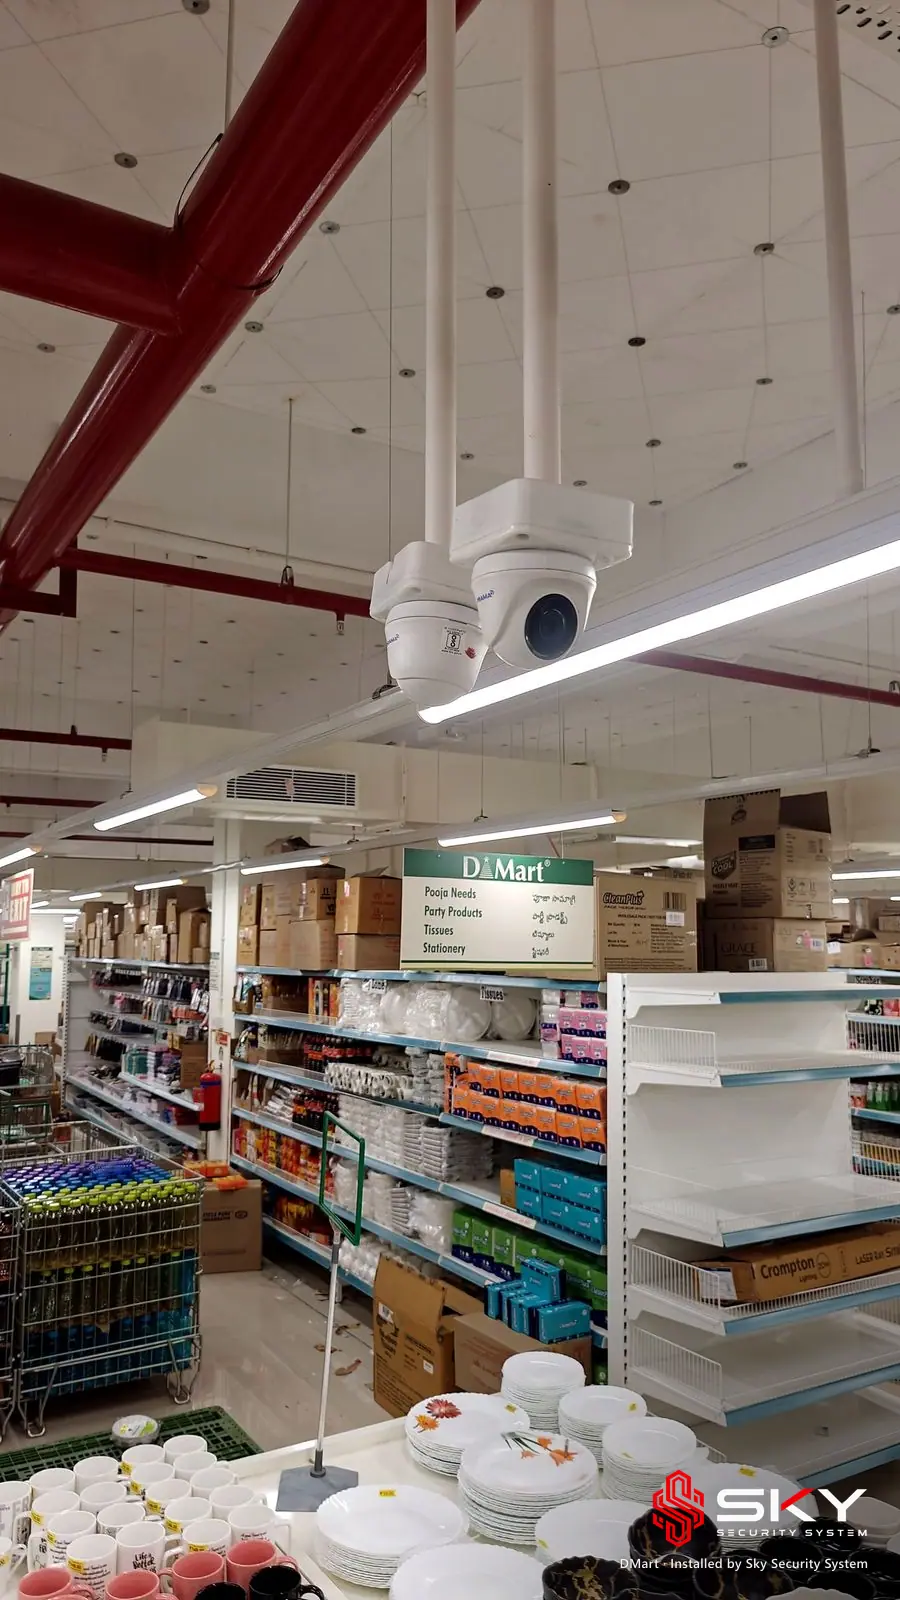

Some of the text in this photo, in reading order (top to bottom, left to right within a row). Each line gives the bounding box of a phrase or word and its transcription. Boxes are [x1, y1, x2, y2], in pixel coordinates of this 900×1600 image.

[424, 886, 477, 900] Pooja Needs
[602, 890, 645, 905] CleanPlus
[424, 905, 483, 919] Party Products
[423, 924, 454, 936] Tissues
[423, 942, 466, 956] Stationery
[481, 986, 504, 1000] Tissues
[760, 1257, 815, 1280] Crompton
